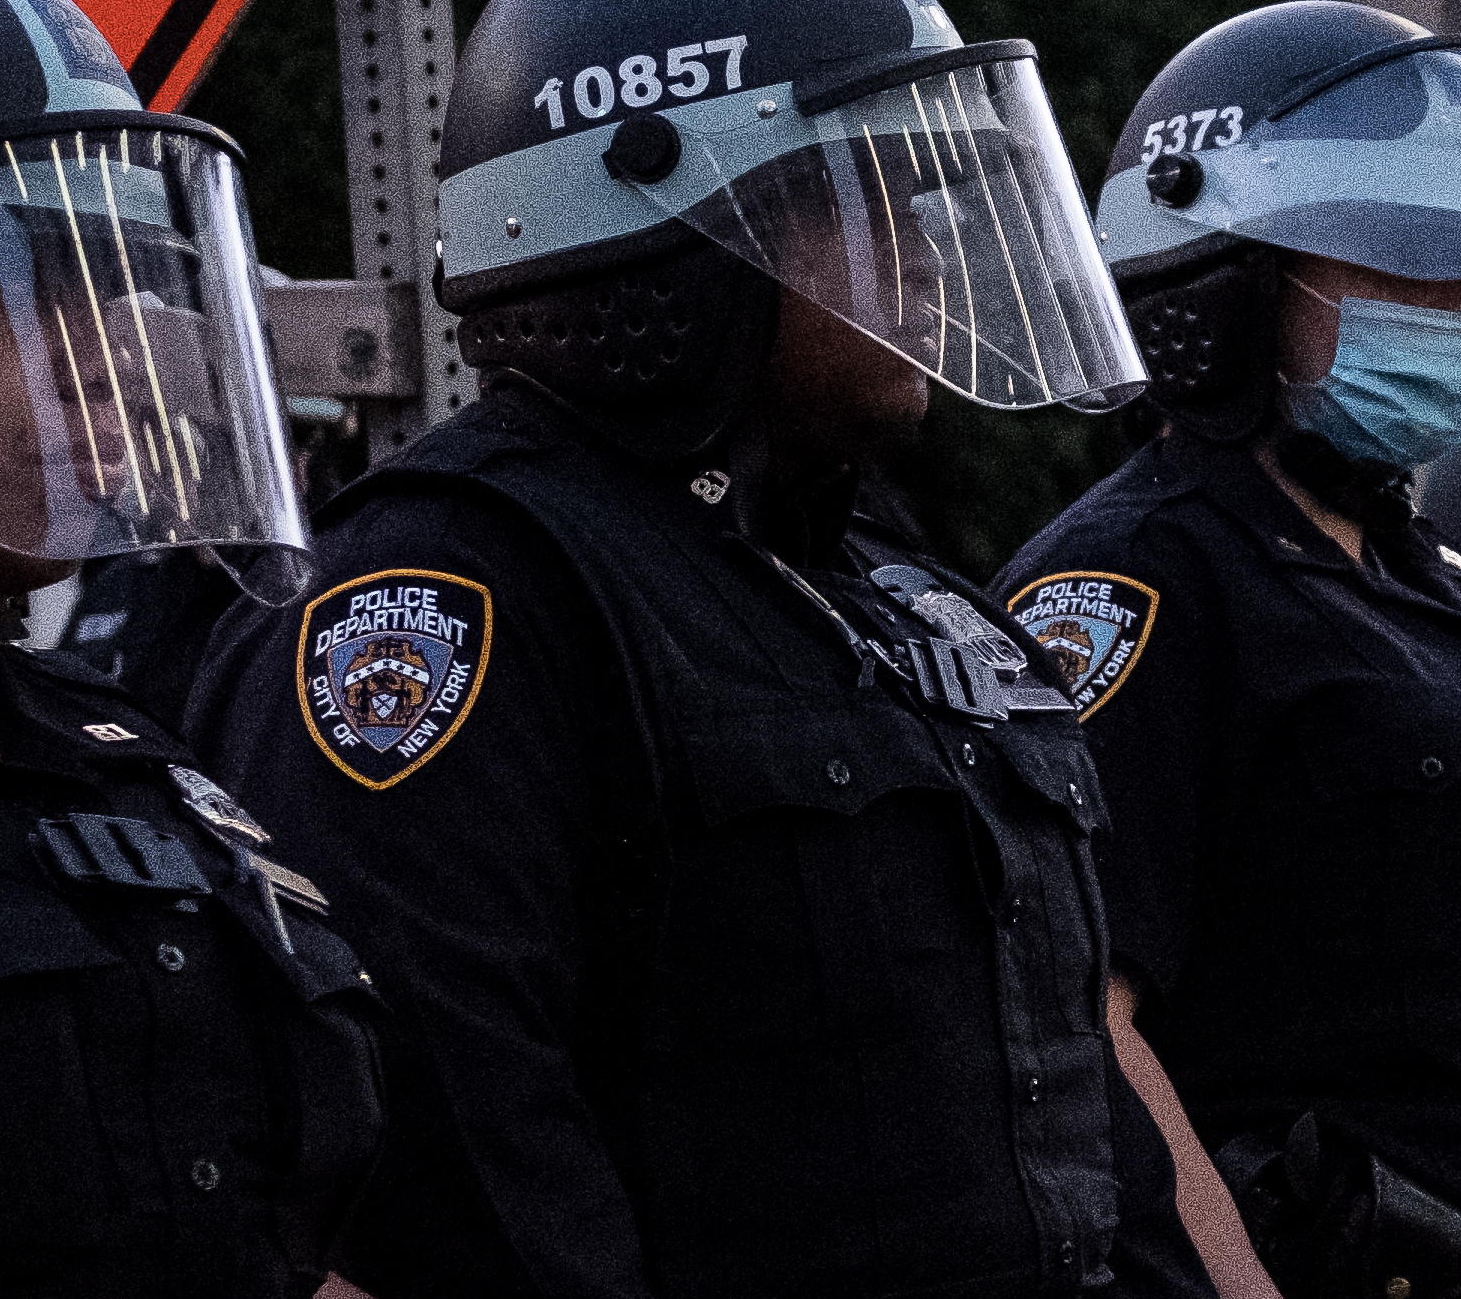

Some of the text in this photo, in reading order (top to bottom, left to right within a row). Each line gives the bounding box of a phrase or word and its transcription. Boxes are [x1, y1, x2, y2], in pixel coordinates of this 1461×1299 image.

[533, 33, 749, 131] 10857
[1139, 104, 1245, 164] 5373
[349, 585, 441, 617] POLICE
[1035, 580, 1114, 603] POLICE
[314, 608, 470, 658] DEPARTMENT
[1092, 638, 1136, 688] YORK
[312, 673, 363, 749] CITY OF
[396, 660, 472, 760] NEW YORK
